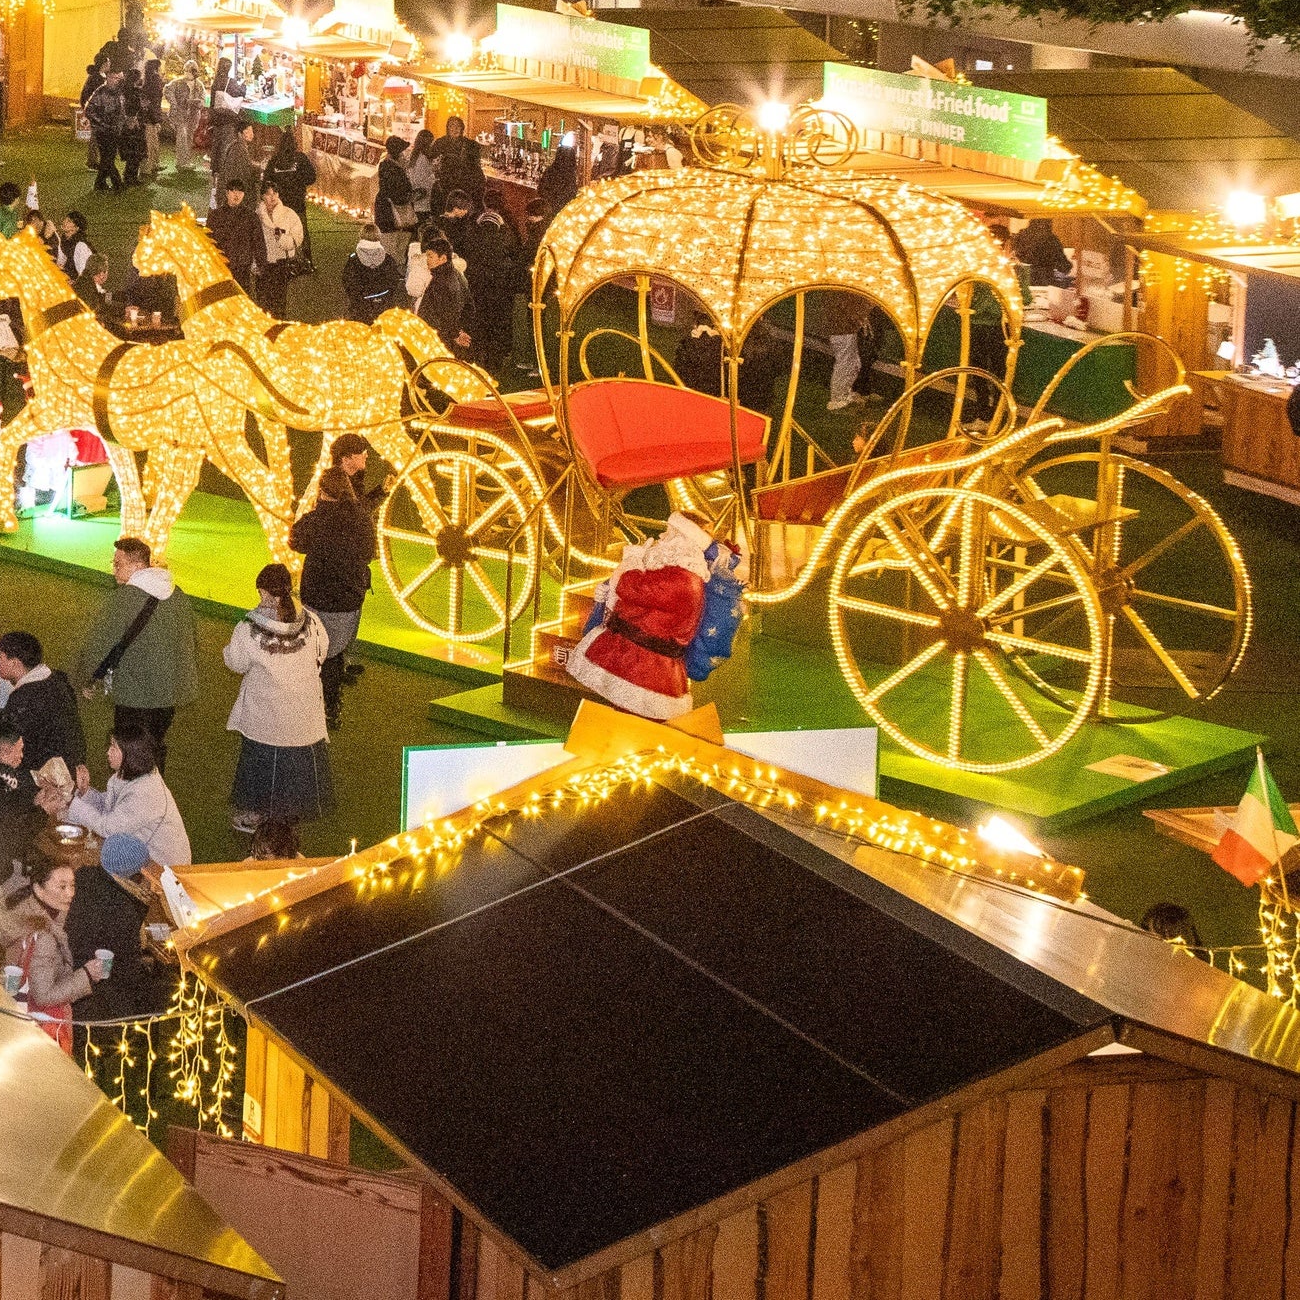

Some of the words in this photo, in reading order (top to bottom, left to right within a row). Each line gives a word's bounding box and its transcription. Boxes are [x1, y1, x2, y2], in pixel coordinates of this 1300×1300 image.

[571, 24, 625, 50] Chocolate
[884, 86, 923, 108] wurst
[936, 90, 973, 115] Fried
[974, 97, 1009, 123] food
[920, 119, 966, 142] DINNER
